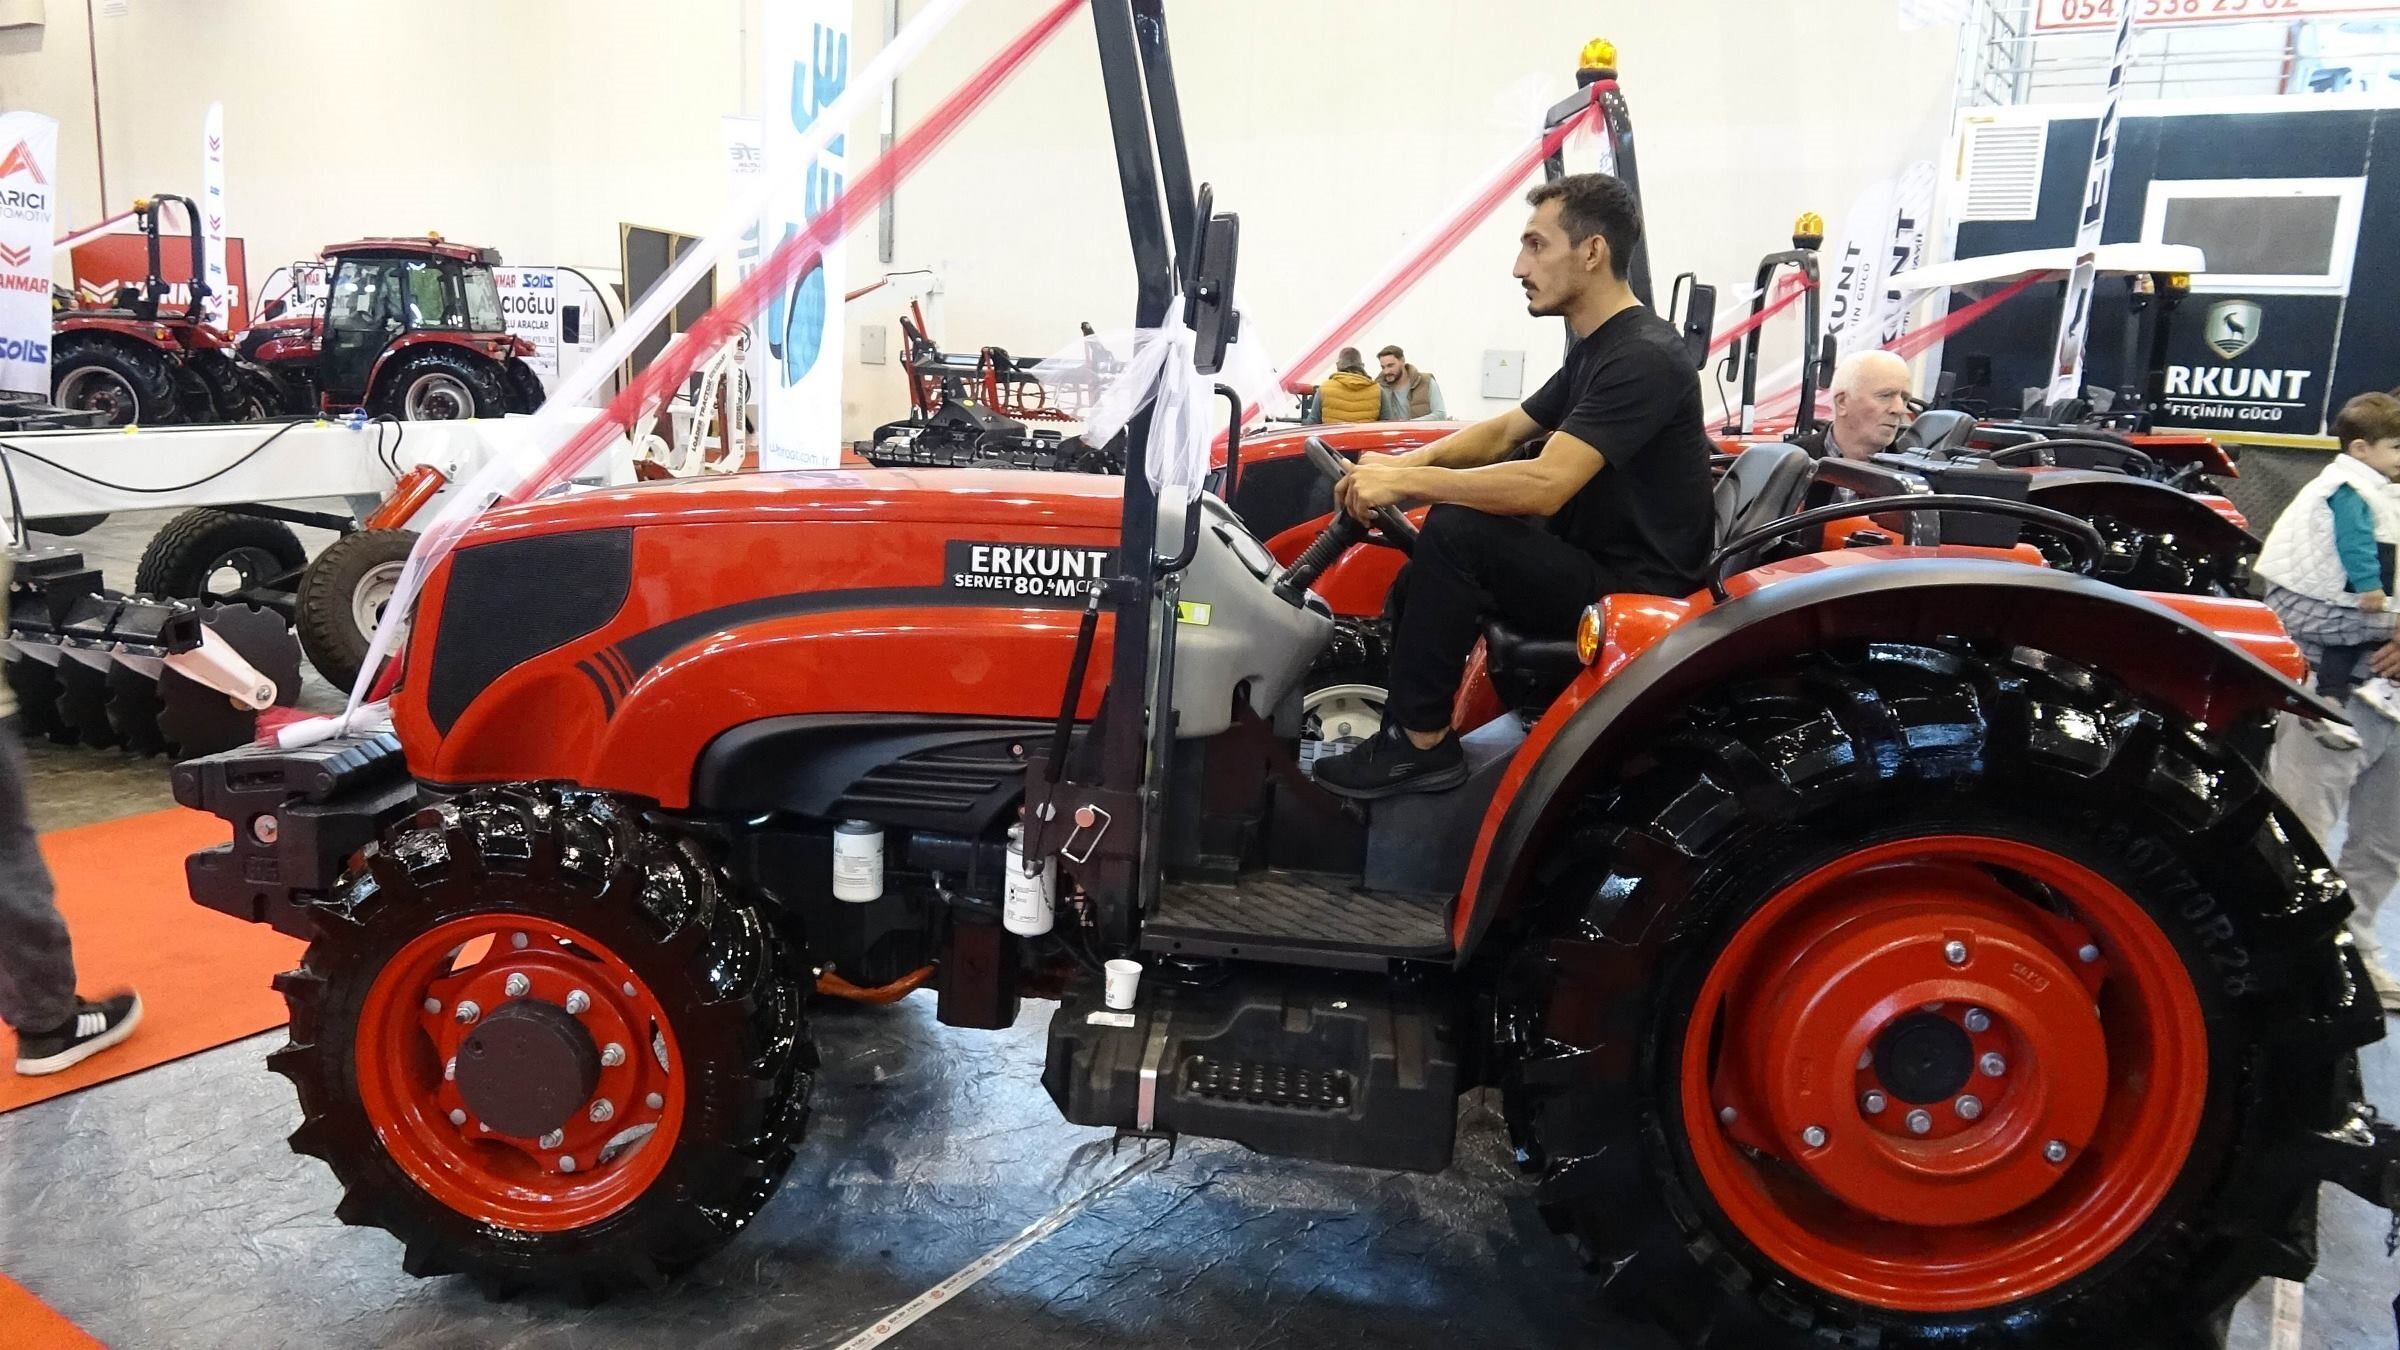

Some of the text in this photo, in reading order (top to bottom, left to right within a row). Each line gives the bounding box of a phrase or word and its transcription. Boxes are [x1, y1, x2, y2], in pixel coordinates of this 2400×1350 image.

[2061, 0, 2120, 20] 054
[971, 545, 1109, 579] ERKUNT
[954, 574, 1013, 590] SERVET
